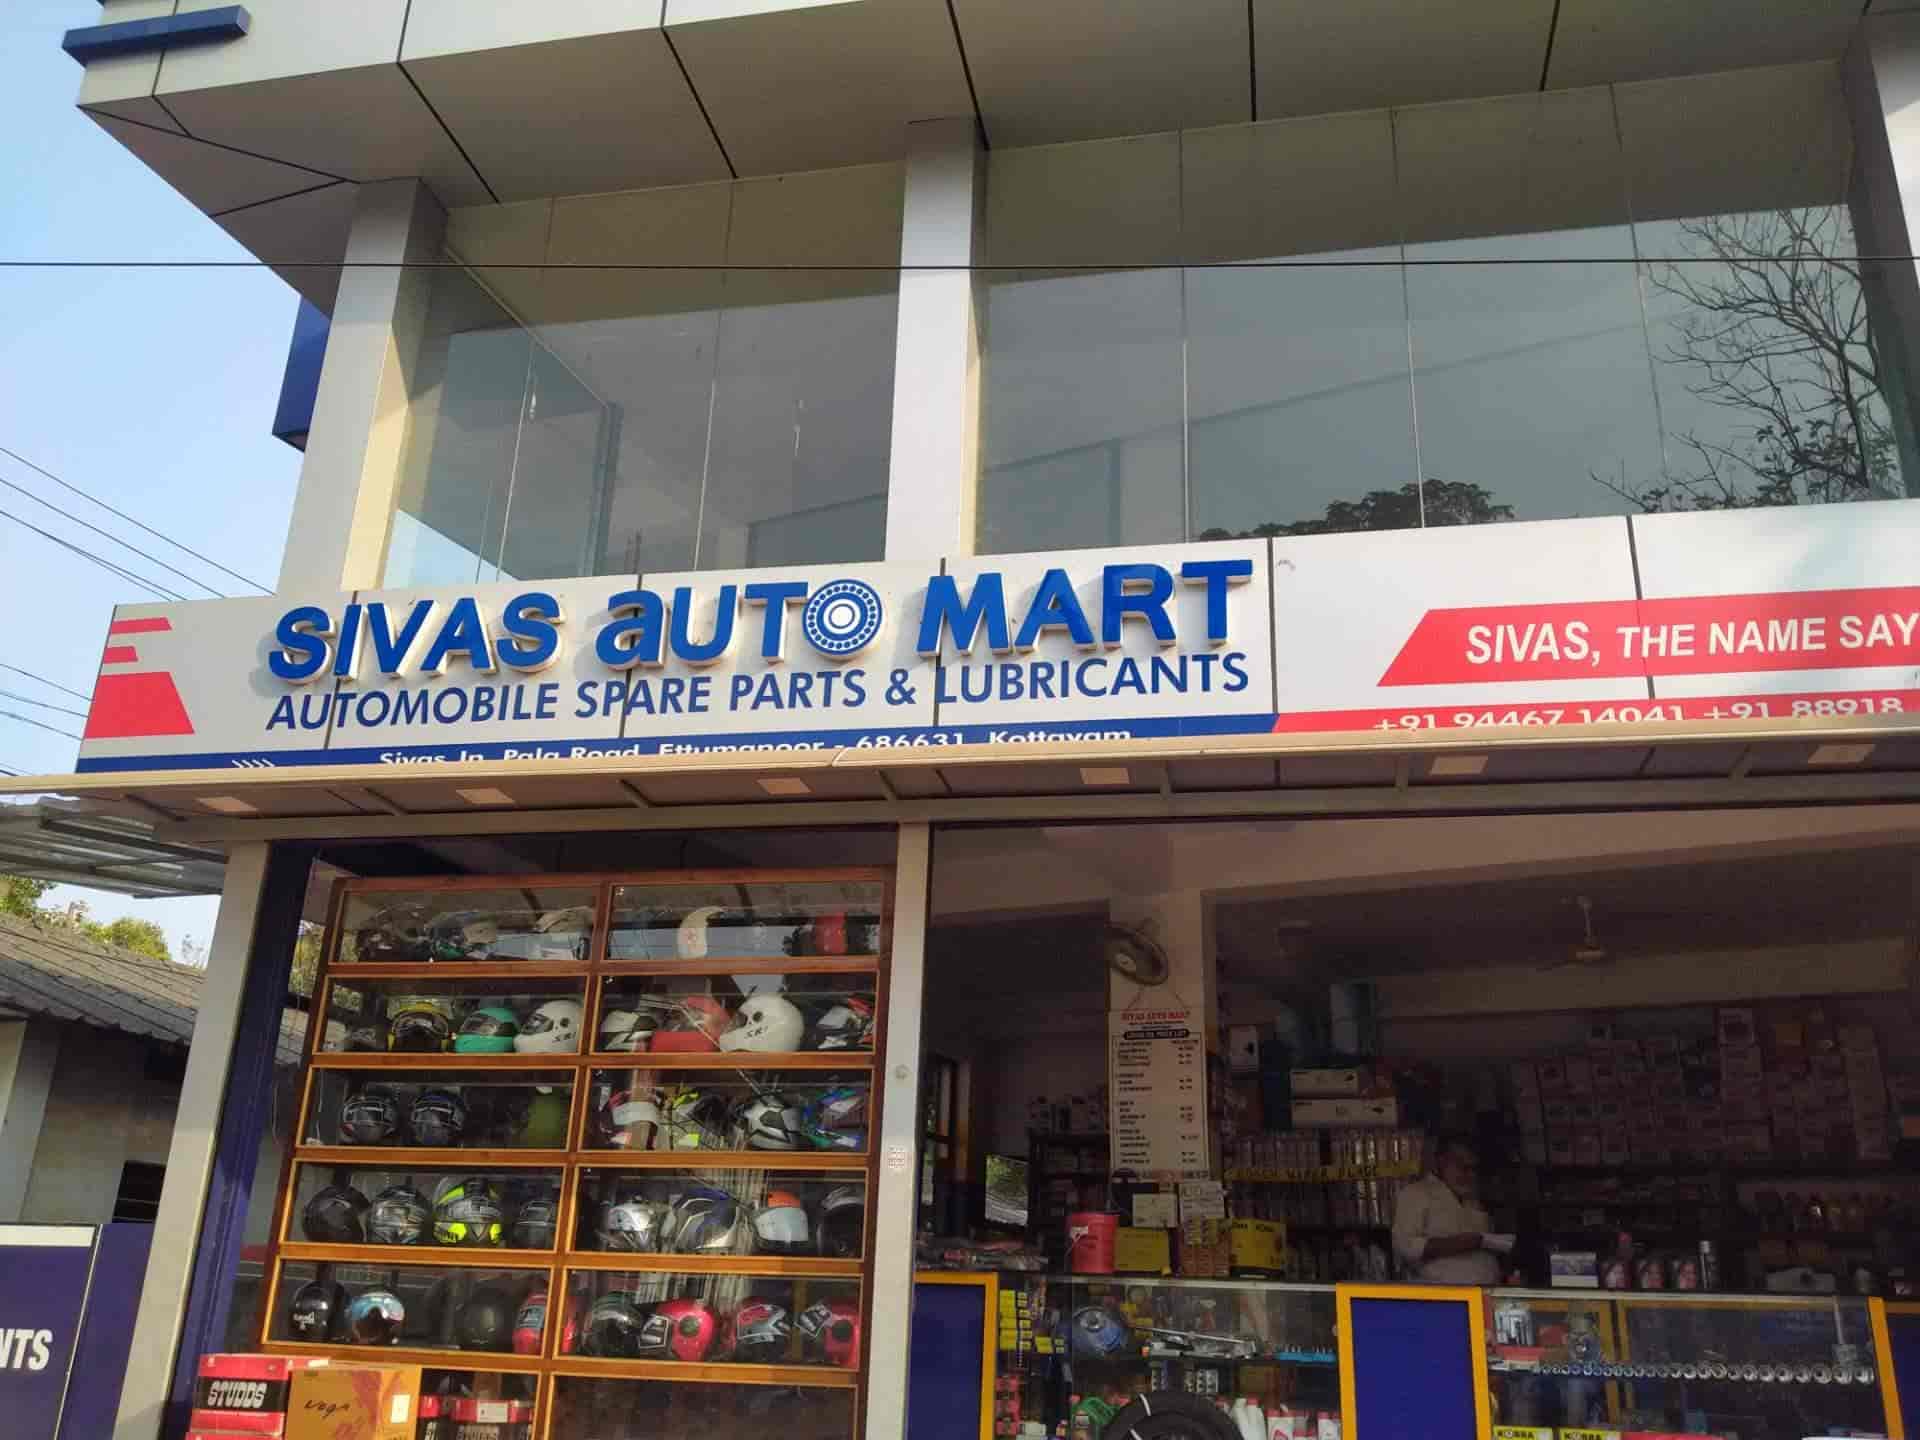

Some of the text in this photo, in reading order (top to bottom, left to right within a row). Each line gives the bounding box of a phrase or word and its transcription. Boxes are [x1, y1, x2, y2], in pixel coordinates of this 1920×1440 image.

[268, 592, 563, 681] SIVAS
[916, 559, 1253, 657] MART
[1465, 620, 1602, 668] SIVAS,
[1615, 623, 1696, 659] THE
[1708, 616, 1827, 656] NAME
[266, 653, 1249, 731] AUTOMOBILE SPARE PARTS & LUBRICANTS
[1453, 710, 1564, 729] 94467
[1578, 704, 1684, 724] 14041
[379, 752, 446, 765] Sivas
[855, 732, 965, 750] 686631
[207, 1380, 268, 1408] STUDDS
